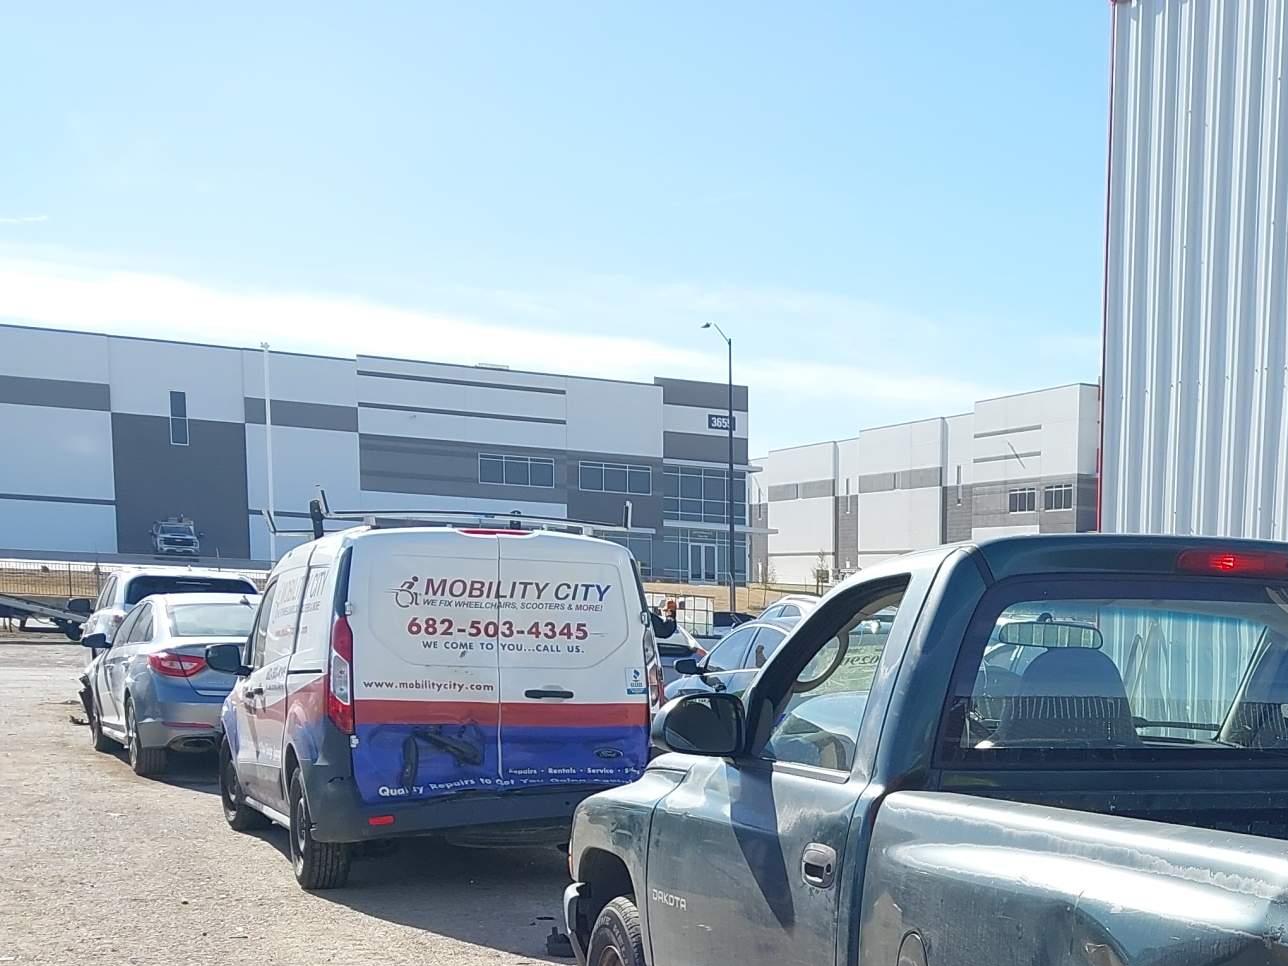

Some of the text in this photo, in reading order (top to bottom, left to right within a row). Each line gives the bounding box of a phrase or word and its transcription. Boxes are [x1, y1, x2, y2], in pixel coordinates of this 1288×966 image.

[424, 578, 611, 602] MOBILITY CITY
[454, 600, 518, 610] WHEELCHAIRS,
[520, 602, 566, 610] SCOOTERS
[575, 604, 603, 612] MORE!
[407, 616, 588, 641] 682-503-4345
[422, 641, 438, 649] WE
[444, 641, 474, 650] COME
[480, 642, 494, 650] TO
[567, 645, 584, 653] US.
[362, 680, 494, 692] www.mobilitycity.com
[548, 767, 577, 775] Rentals
[586, 767, 614, 775] Service
[652, 888, 687, 912] DAKOTA
